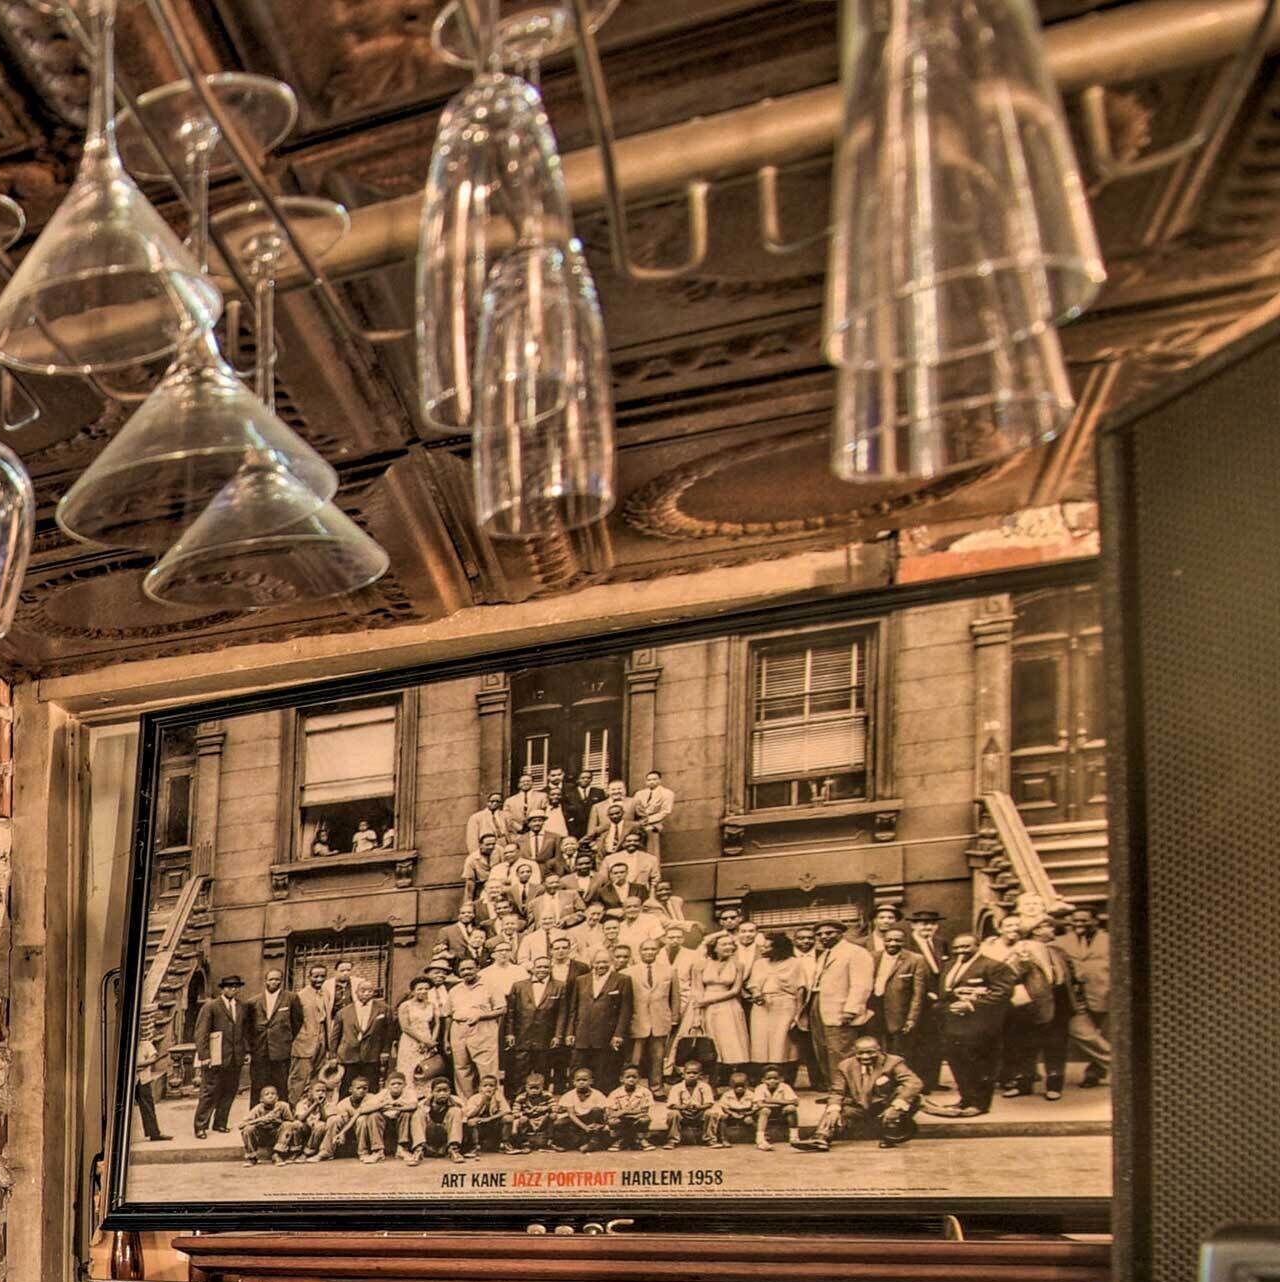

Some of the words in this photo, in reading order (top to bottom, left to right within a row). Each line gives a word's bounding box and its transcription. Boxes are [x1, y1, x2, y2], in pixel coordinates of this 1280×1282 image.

[440, 1172, 468, 1189] ART
[471, 1172, 507, 1188] KANE
[511, 1171, 541, 1188] JAZZ
[547, 1170, 617, 1187] PORTRAIT
[621, 1170, 683, 1186] HARLEM
[687, 1169, 724, 1186] 1958
